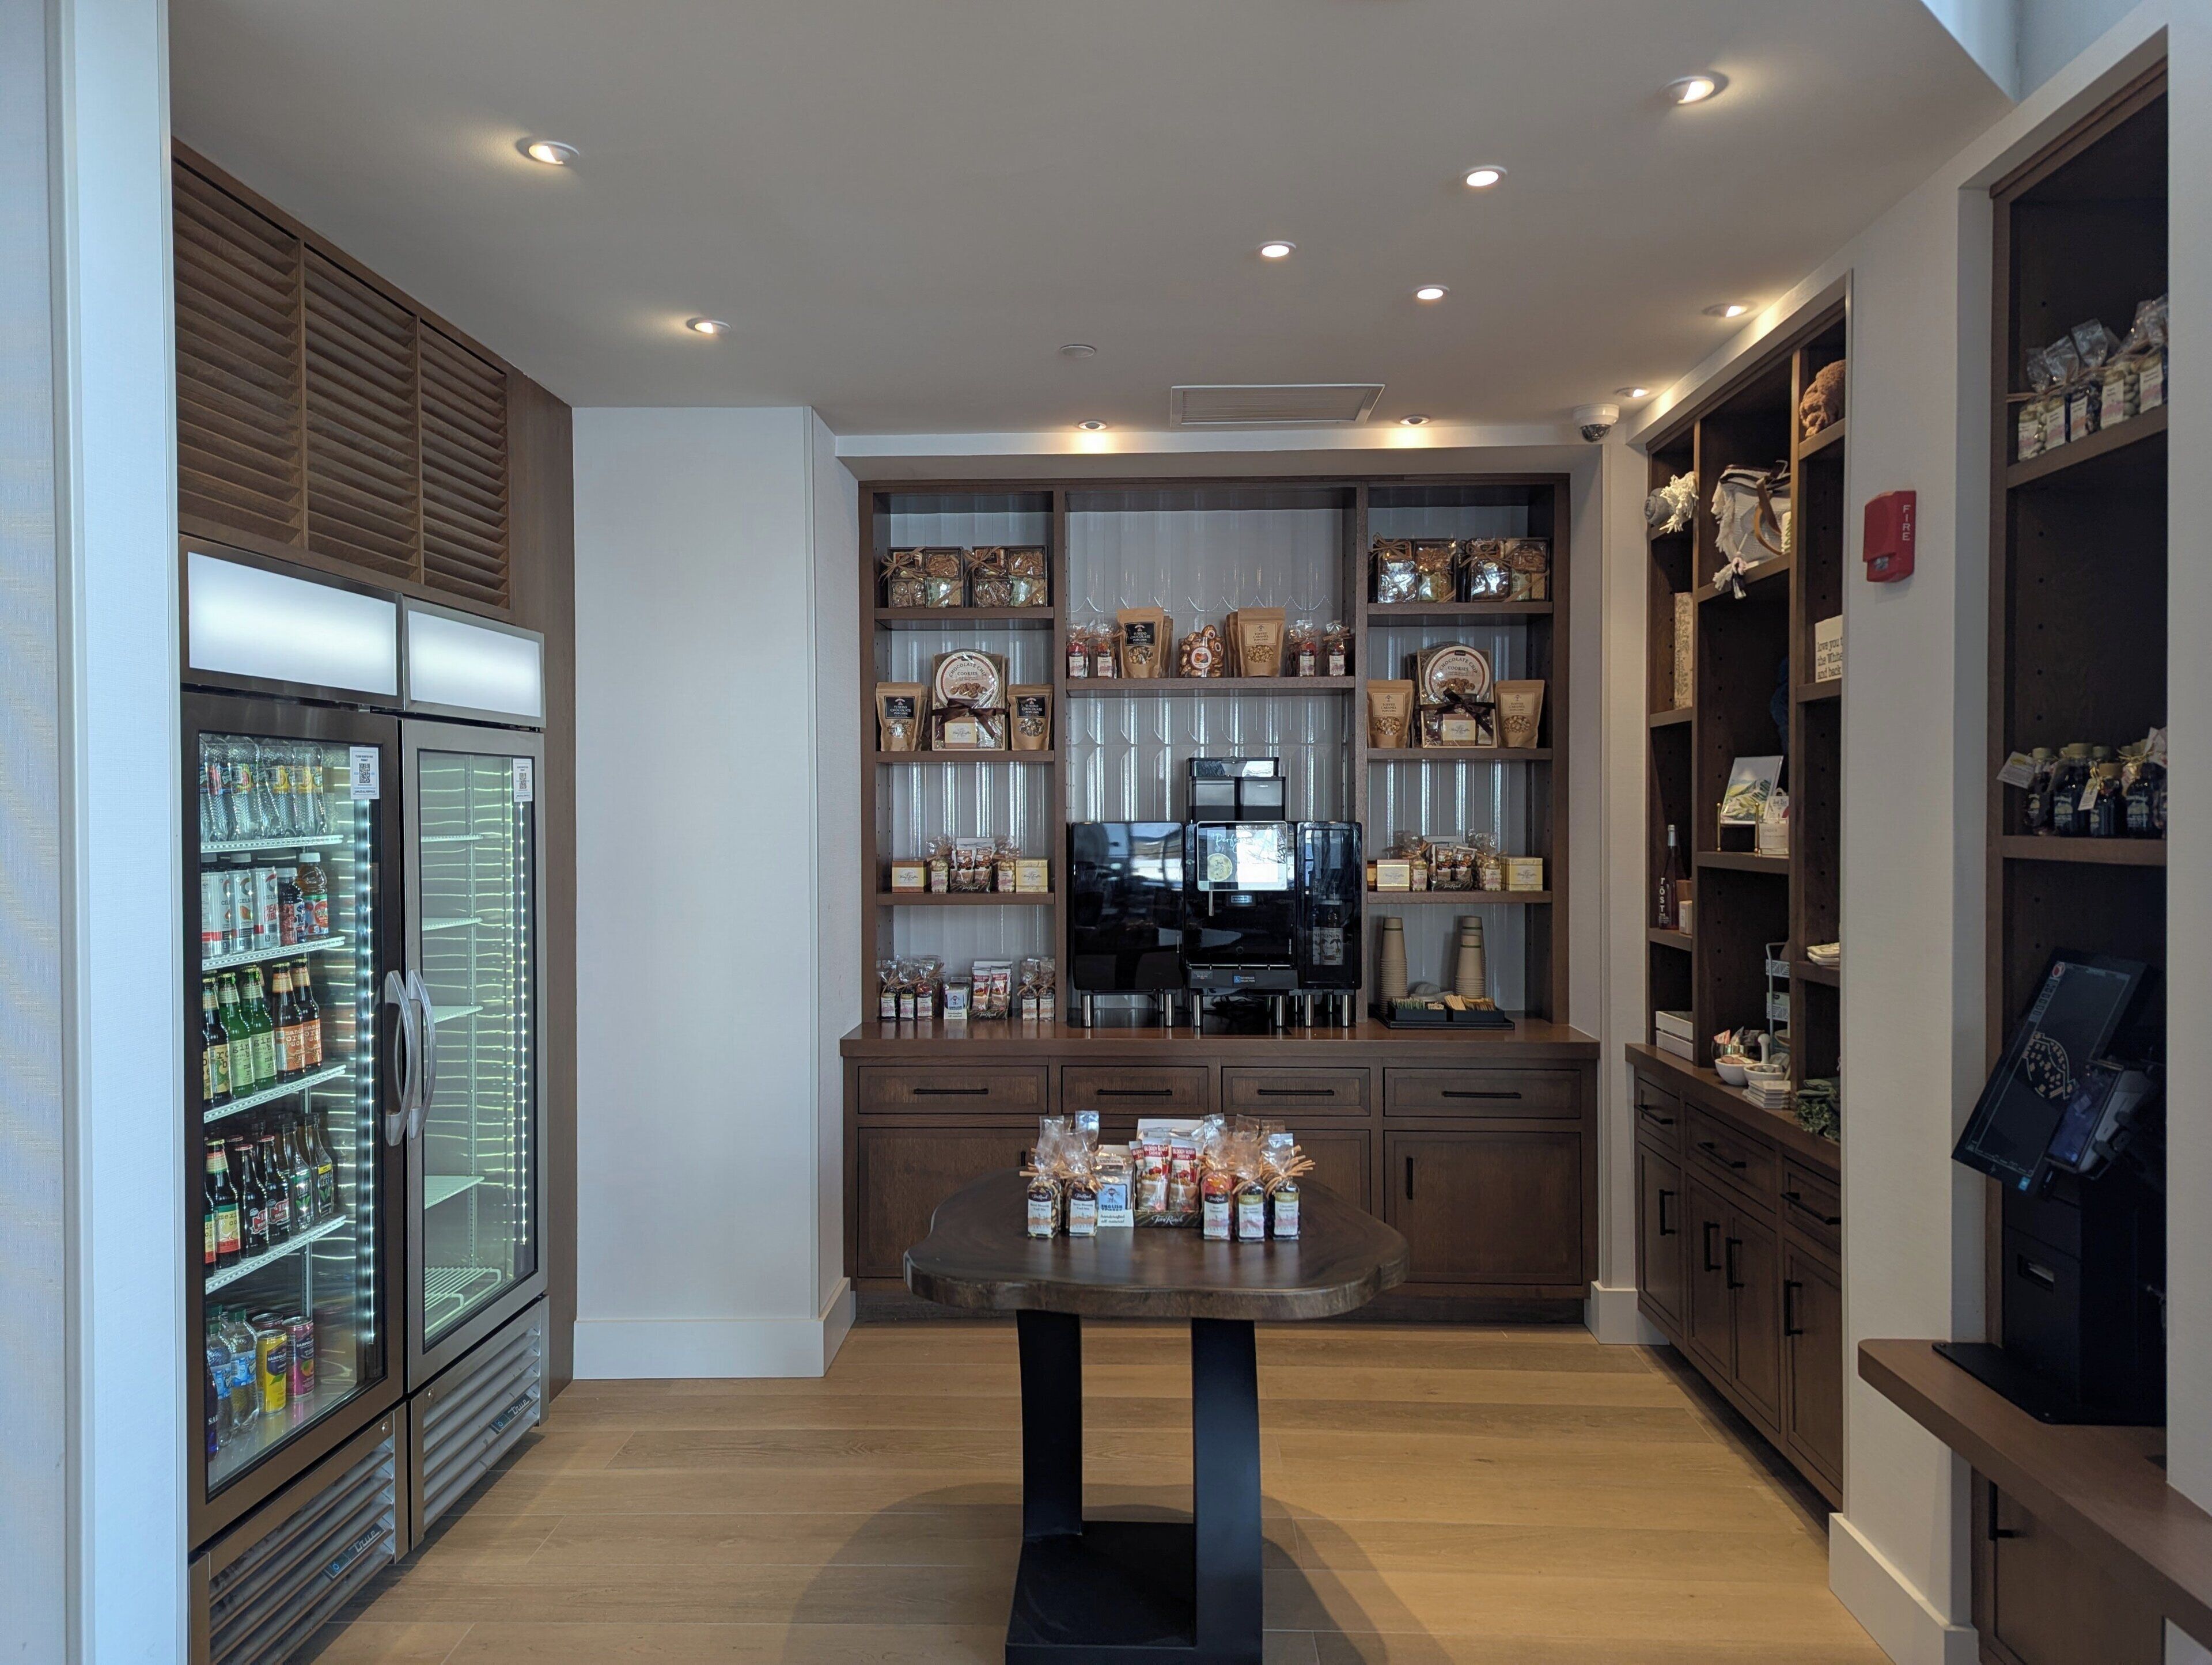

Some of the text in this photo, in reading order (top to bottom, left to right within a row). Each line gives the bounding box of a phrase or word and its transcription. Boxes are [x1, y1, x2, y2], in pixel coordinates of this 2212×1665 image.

[1902, 505, 1911, 541] FIRE
[1817, 642, 1829, 652] love
[1830, 639, 1840, 651] you
[1439, 657, 1478, 673] CHOCOLATE CHIP
[1817, 655, 1826, 666] the
[949, 662, 987, 677] CHOCOLATE CHIP
[1817, 665, 1842, 679] and back
